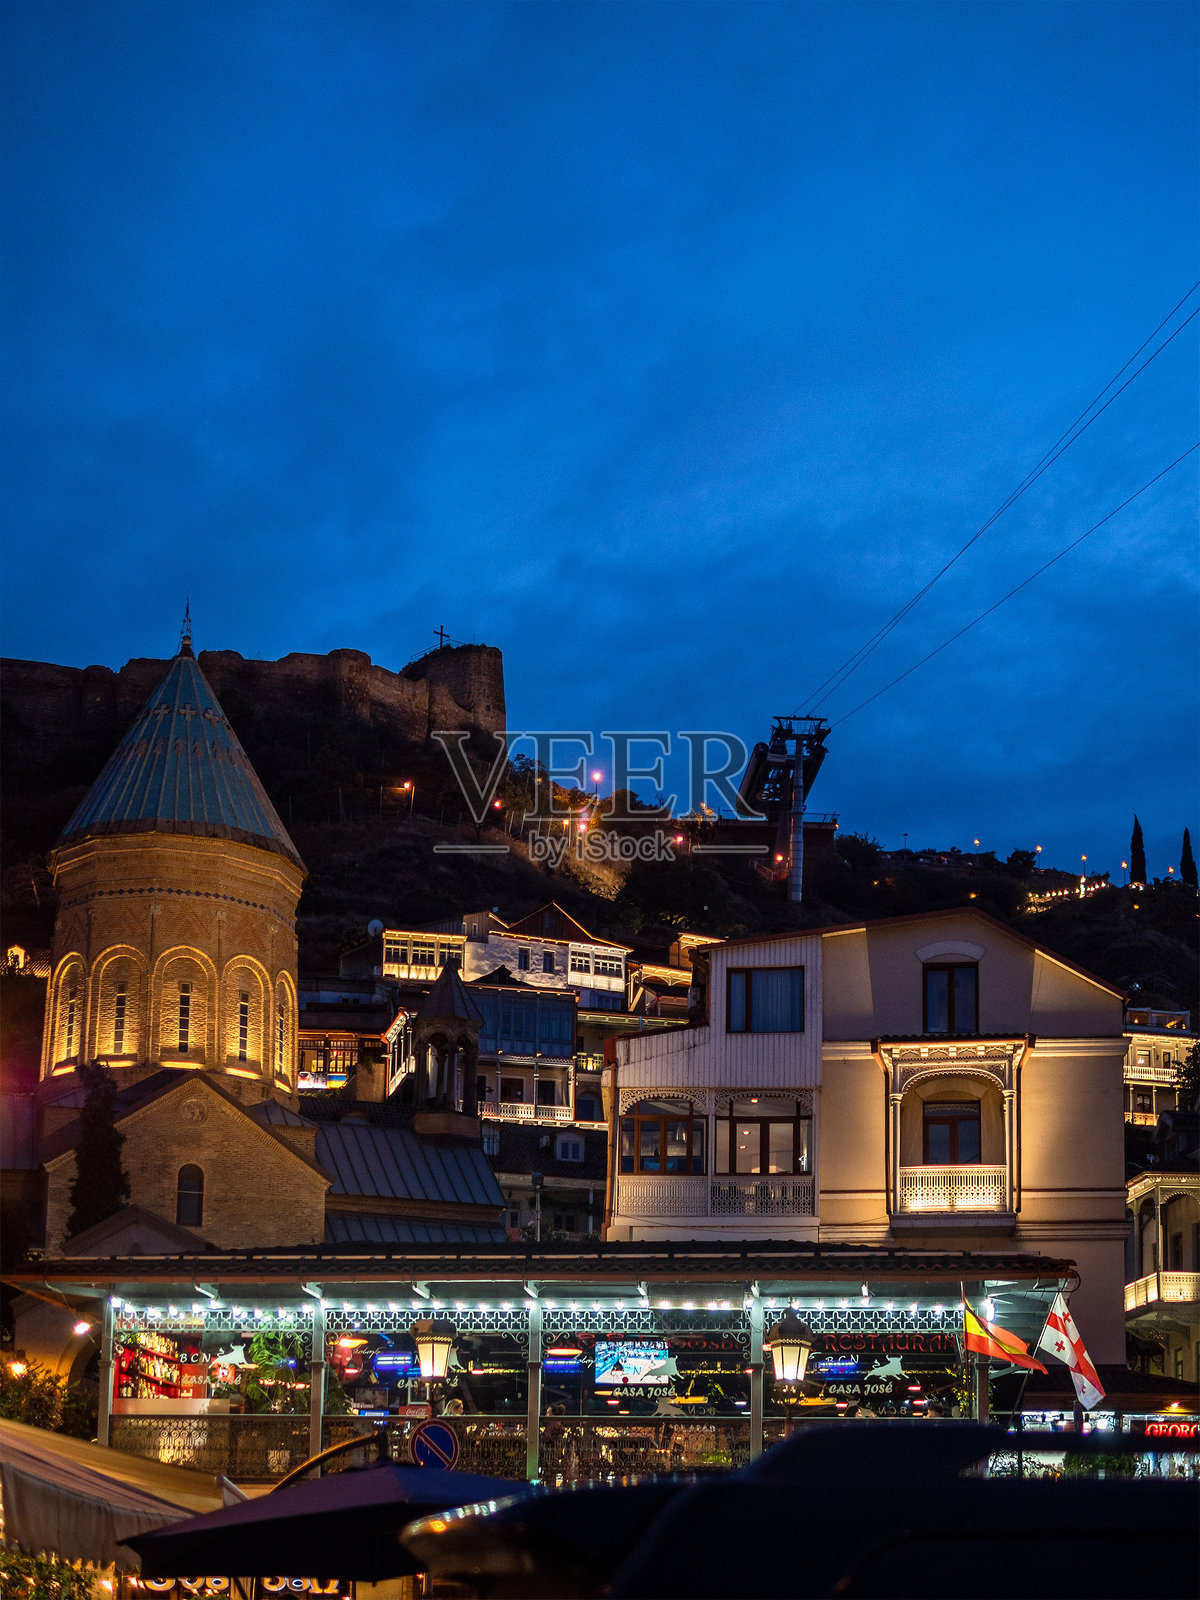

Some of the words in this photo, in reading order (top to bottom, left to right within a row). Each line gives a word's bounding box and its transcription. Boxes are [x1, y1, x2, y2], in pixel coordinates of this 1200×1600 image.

[613, 1387, 645, 1396] CASA
[647, 1385, 676, 1398] JOSÉ
[829, 1384, 861, 1394] CASA
[864, 1382, 893, 1395] JOSÉ
